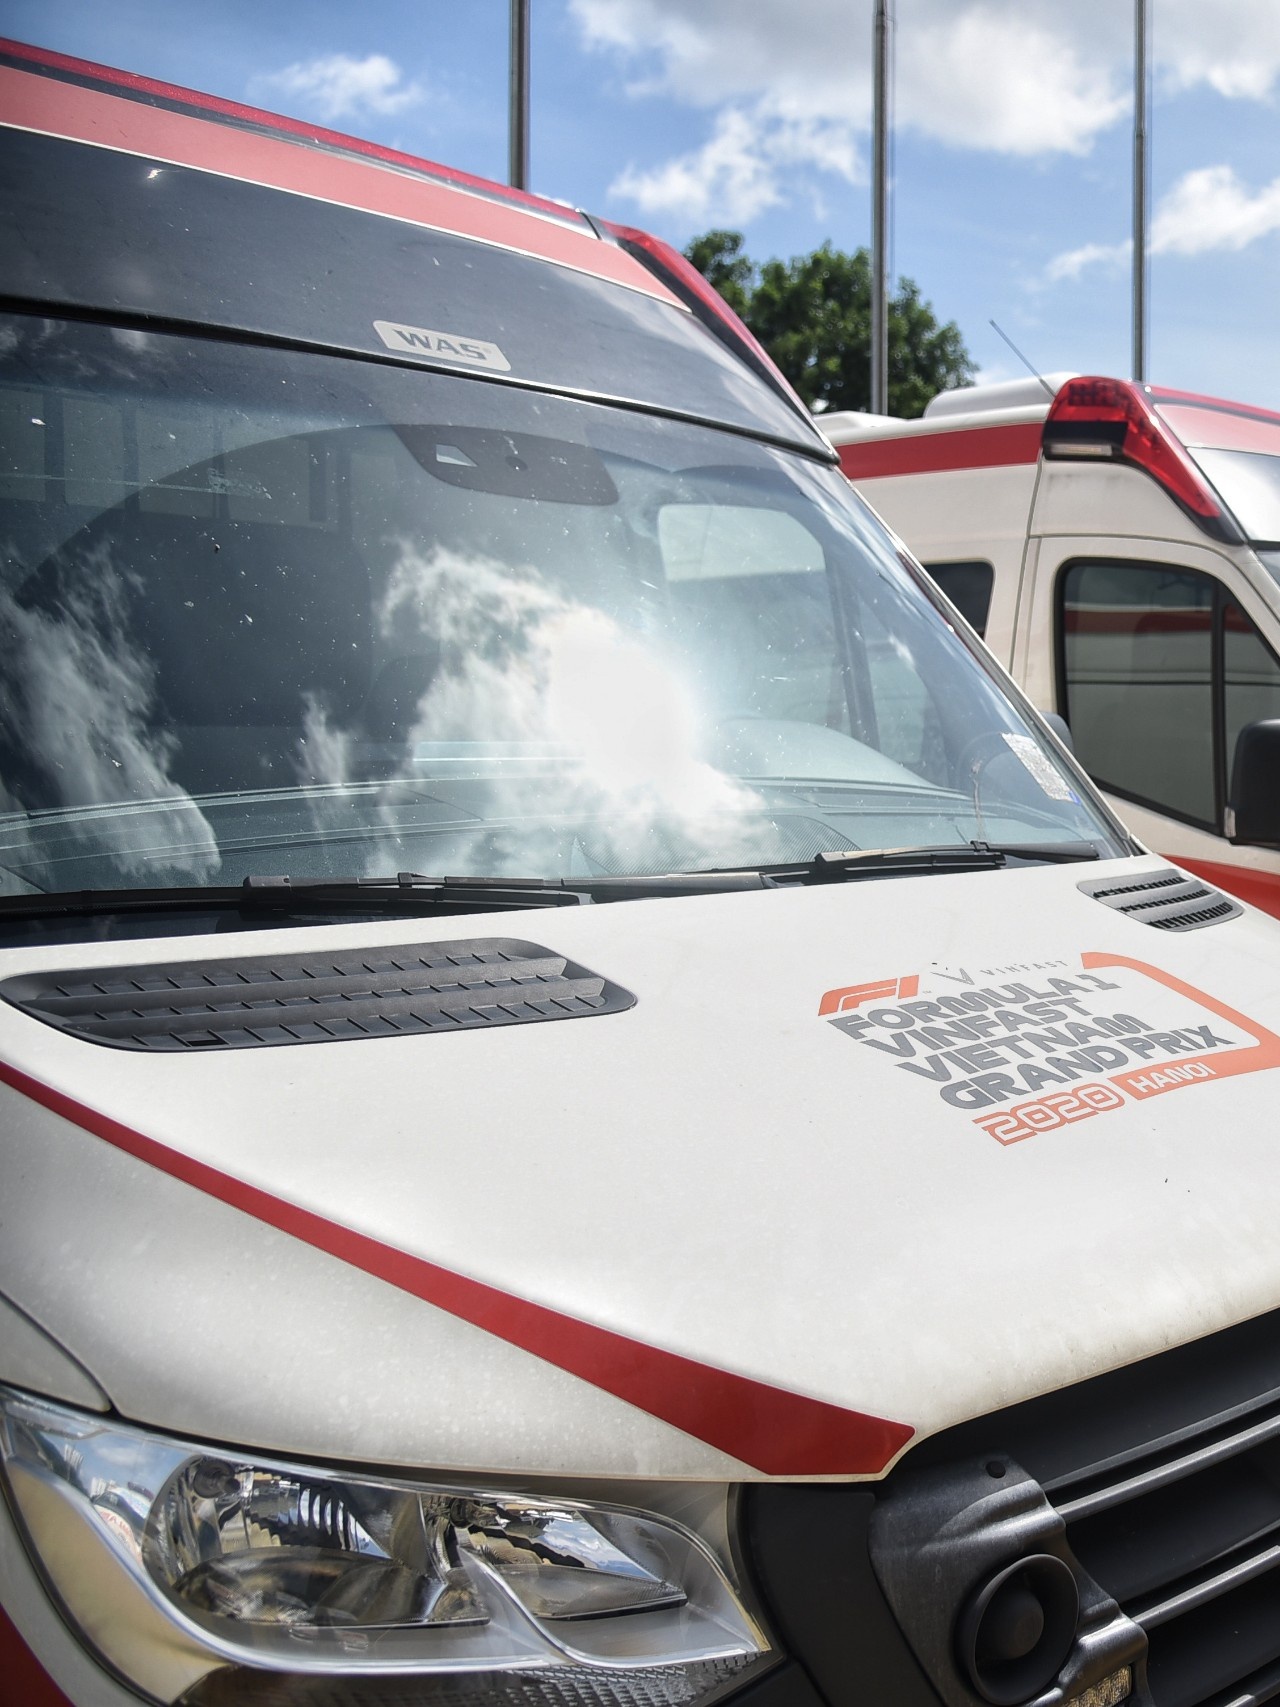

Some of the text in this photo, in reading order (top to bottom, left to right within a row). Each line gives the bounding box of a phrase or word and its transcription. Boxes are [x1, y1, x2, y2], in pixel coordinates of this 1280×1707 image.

[393, 329, 487, 361] WAS
[980, 960, 1068, 976] VINFAST
[826, 973, 1122, 1040] FORMULA 1
[860, 998, 1084, 1058] VINFAST
[895, 1013, 1156, 1082] VIETNAM
[939, 1025, 1236, 1109] GRAND PRIX
[972, 1062, 1216, 1146] 2020 HANOI
